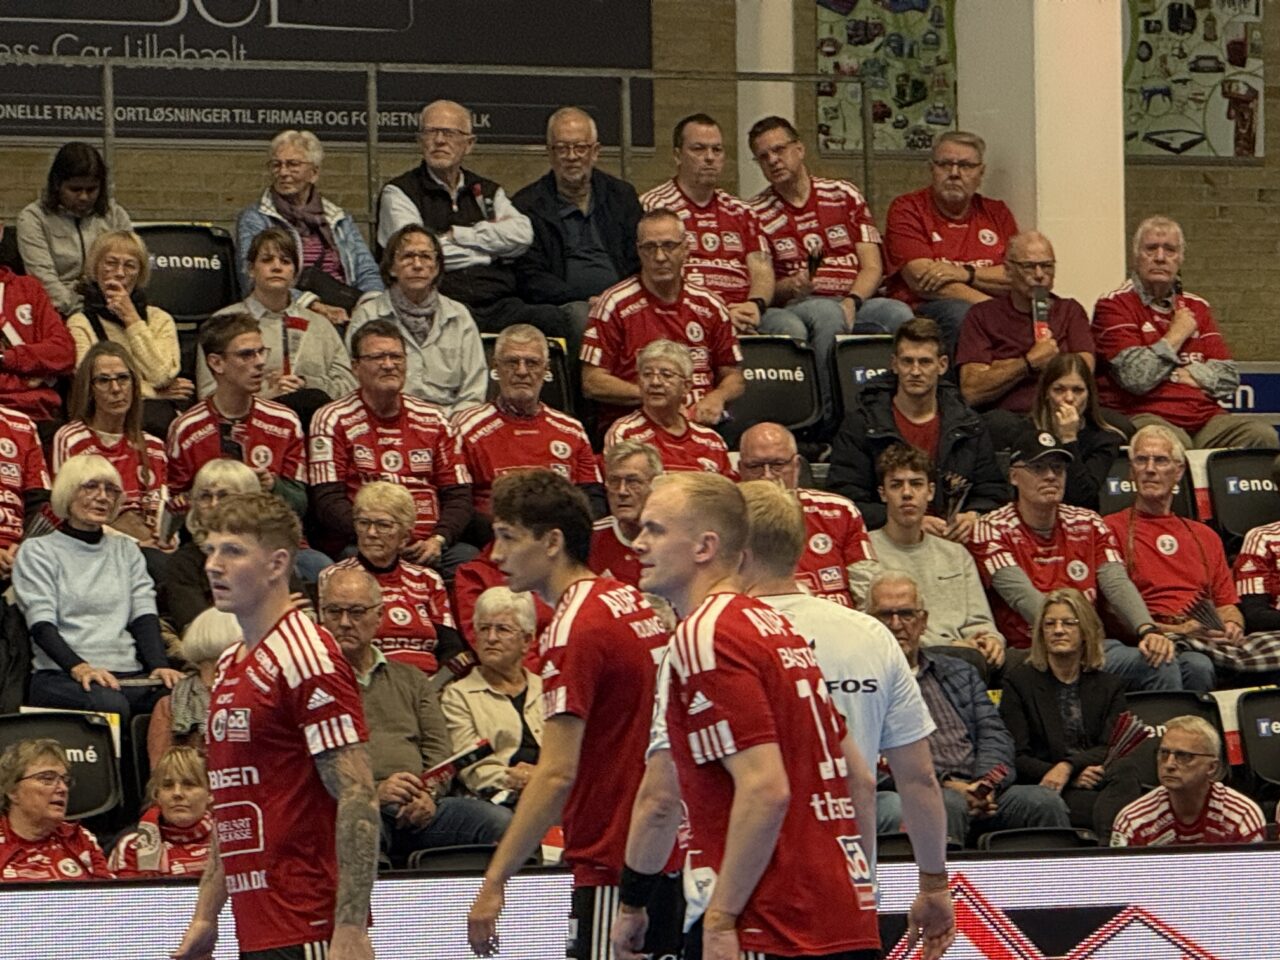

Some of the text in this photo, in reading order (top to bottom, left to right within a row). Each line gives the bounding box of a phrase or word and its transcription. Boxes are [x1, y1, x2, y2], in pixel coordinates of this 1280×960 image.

[54, 105, 230, 122] TRANSORTLØSNINGER
[232, 109, 255, 123] TIL
[258, 110, 322, 124] FIRMAER
[328, 111, 348, 124] OG
